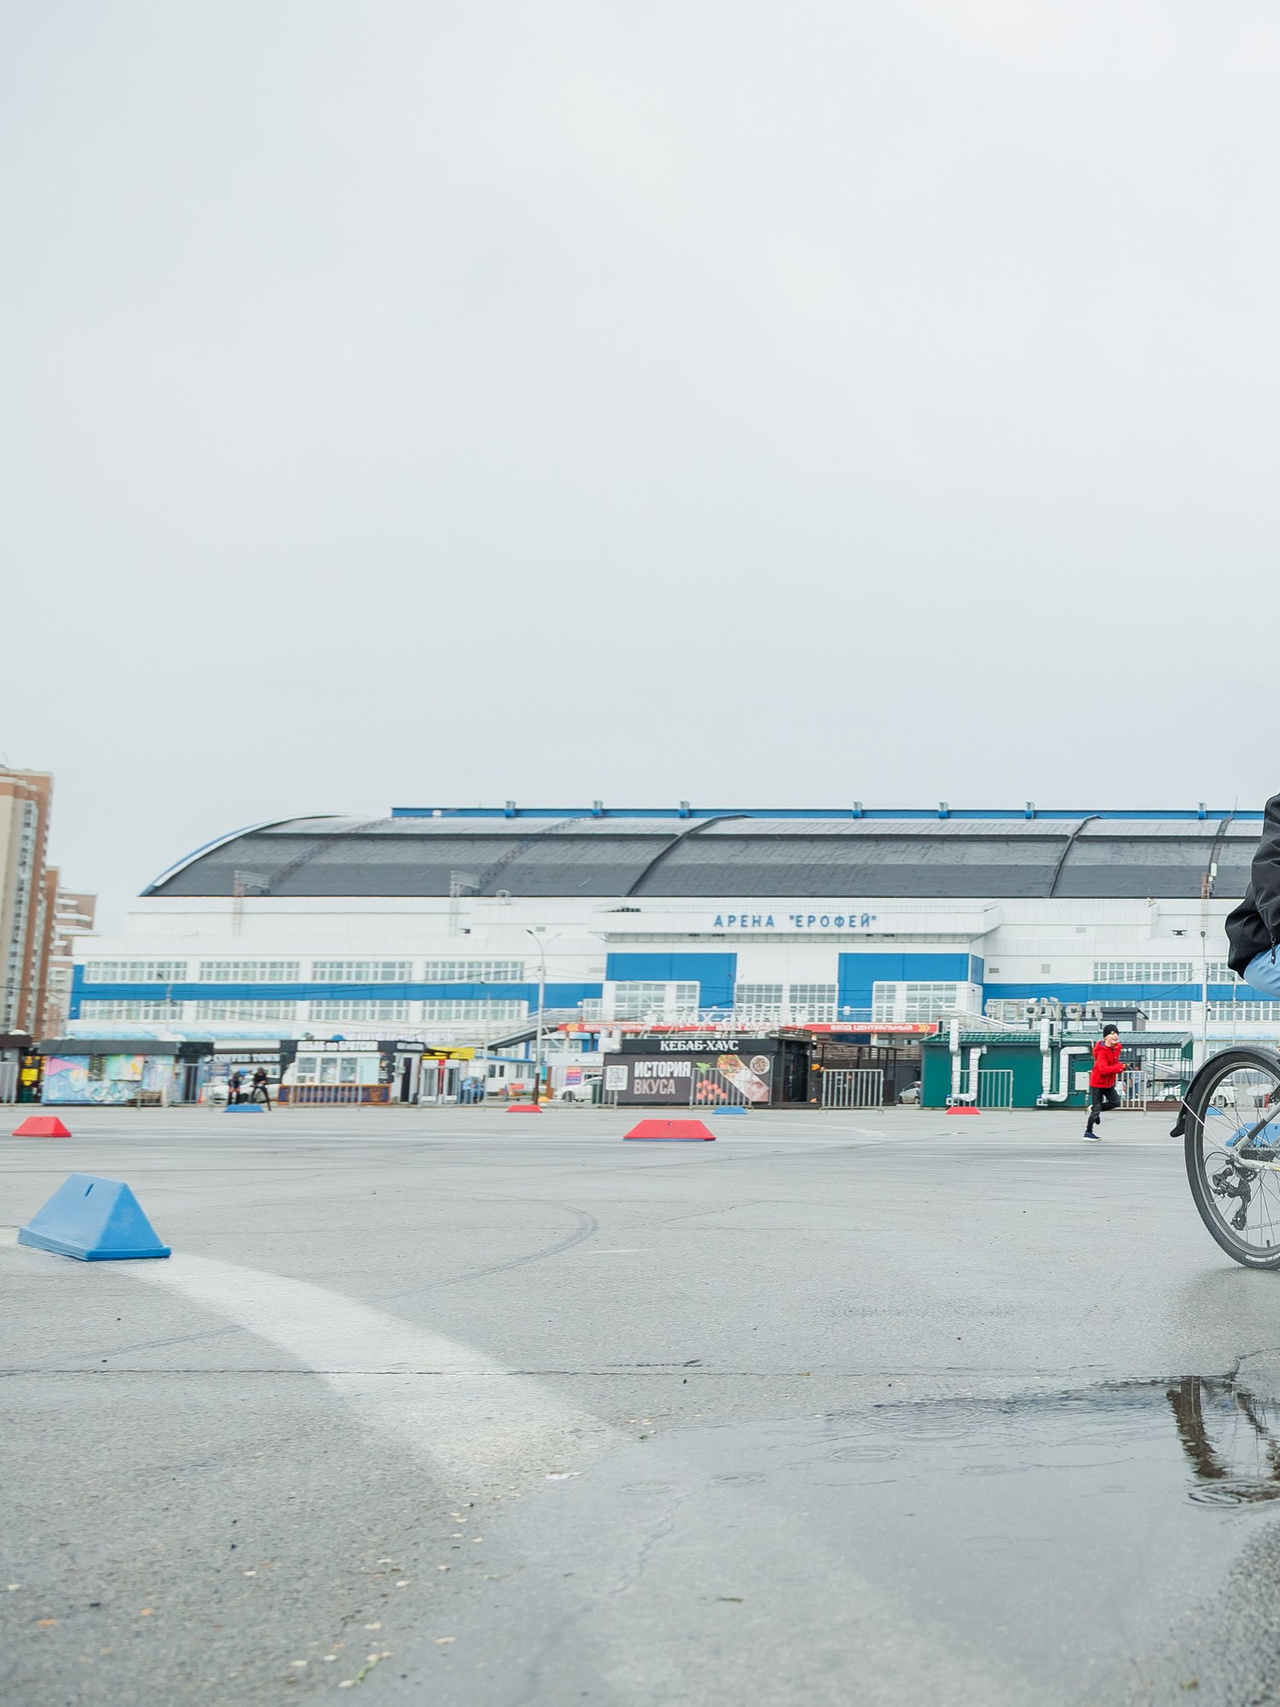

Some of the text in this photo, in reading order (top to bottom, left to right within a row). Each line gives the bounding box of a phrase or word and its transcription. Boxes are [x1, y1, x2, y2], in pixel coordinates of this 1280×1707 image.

[714, 912, 877, 928] АРЕНА "ЕРОФЕЙ"
[830, 1024, 914, 1032] ВХОД ЦЕНТРАЛЬНЫЙ
[660, 1039, 740, 1052] КЕБАБ-ХАУС
[212, 1053, 251, 1063] COFFEE
[633, 1061, 692, 1078] ИСТОРИЯ
[633, 1078, 676, 1095] ВКУСА
